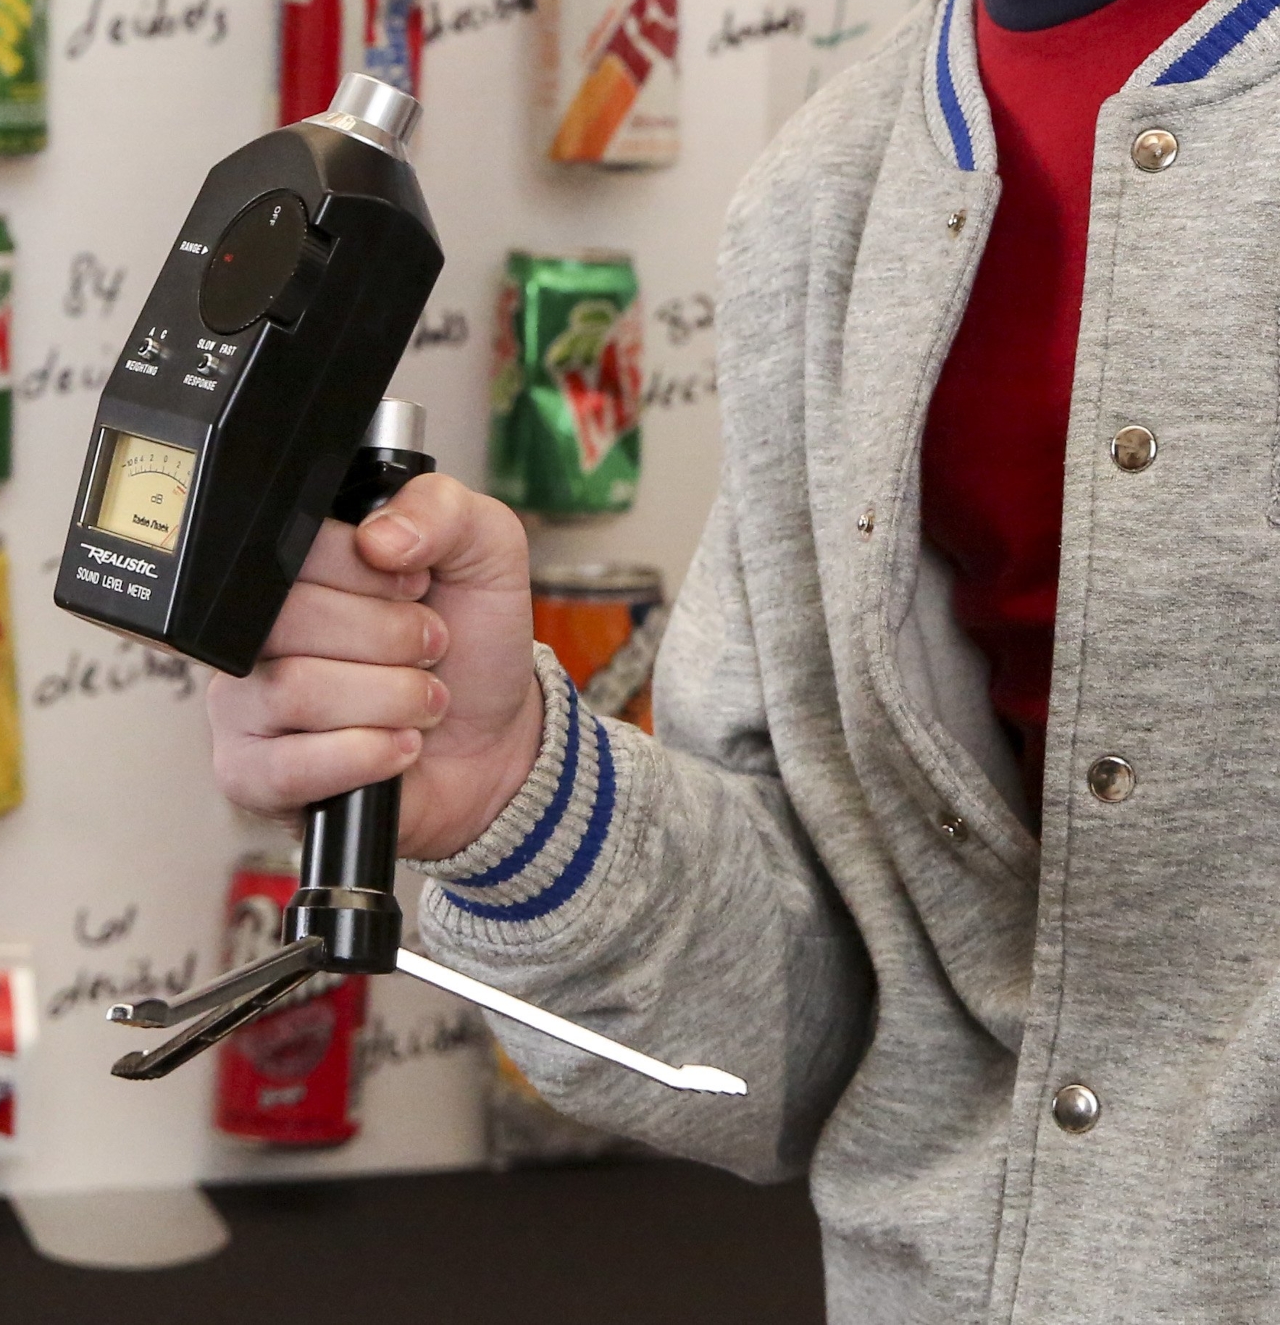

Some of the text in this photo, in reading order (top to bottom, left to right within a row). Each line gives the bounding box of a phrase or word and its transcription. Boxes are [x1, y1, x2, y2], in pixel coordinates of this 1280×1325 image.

[179, 240, 202, 254] RANGE
[148, 326, 168, 340] A C
[196, 338, 237, 356] SLOW FAST
[125, 359, 159, 376] WEIGHTING
[182, 374, 218, 391] RESPONSE
[150, 493, 163, 505] dB
[76, 566, 152, 601] SOUND LEVEL METER
